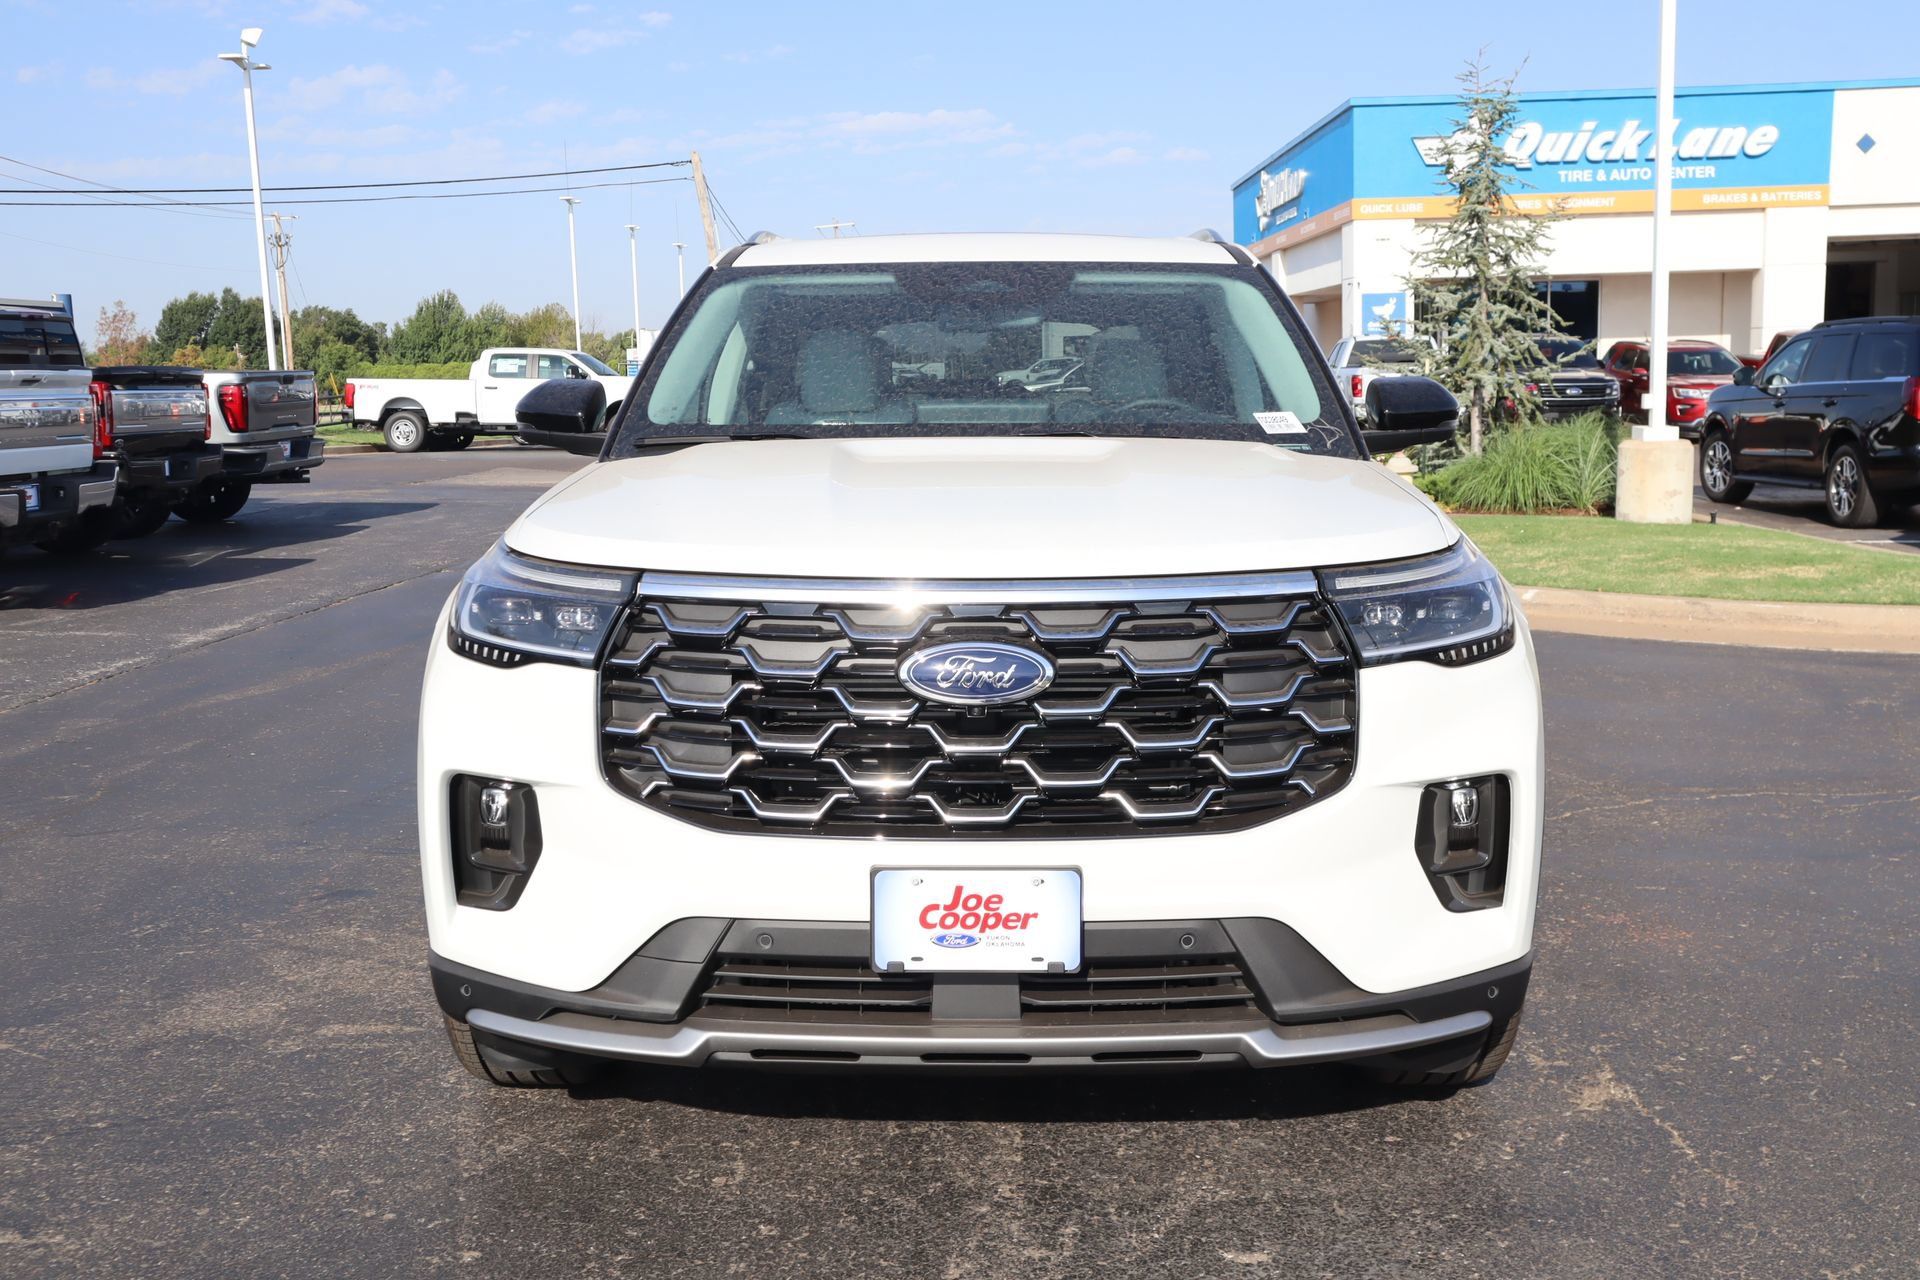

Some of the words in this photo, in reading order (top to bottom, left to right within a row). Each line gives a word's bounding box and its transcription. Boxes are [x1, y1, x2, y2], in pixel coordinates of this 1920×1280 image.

[1503, 119, 1652, 169] Quick
[1648, 118, 1780, 159] ane
[1559, 170, 1593, 182] TIRE
[1596, 169, 1606, 181] &
[1610, 168, 1651, 180] AUTO
[1671, 165, 1716, 179] ENTER
[1703, 193, 1748, 204] BRAKES
[1761, 190, 1822, 202] BATTERIES
[1360, 204, 1393, 214] QUICK
[1395, 203, 1424, 213] LUBE
[937, 655, 1017, 689] Ford
[943, 885, 1004, 912] Joe
[919, 903, 1039, 933] Cooper
[943, 934, 969, 945] Ford
